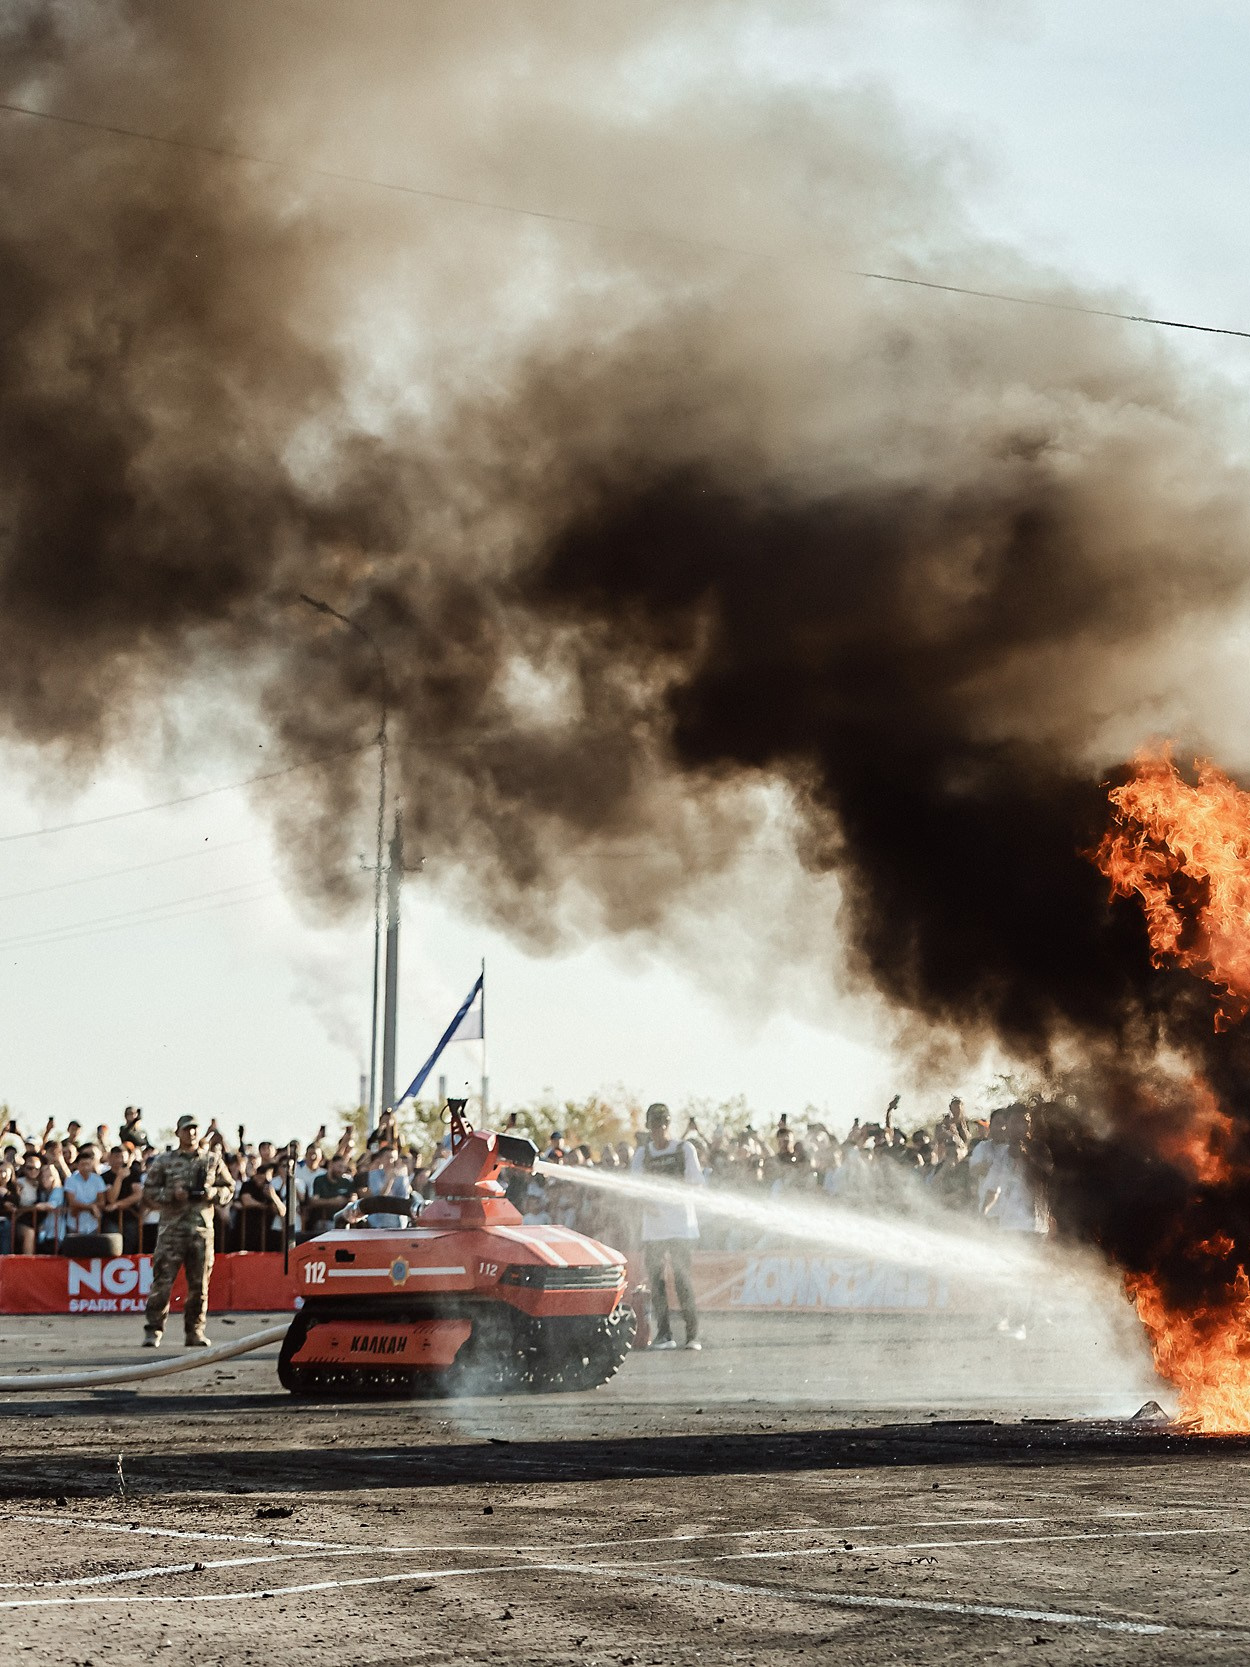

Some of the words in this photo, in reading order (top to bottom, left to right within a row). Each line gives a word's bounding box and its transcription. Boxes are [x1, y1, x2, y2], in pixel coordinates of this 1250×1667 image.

[304, 1261, 327, 1283] 112
[478, 1262, 499, 1277] 112
[69, 1298, 118, 1312] SPARK
[350, 1335, 408, 1354] КАЛКАН
